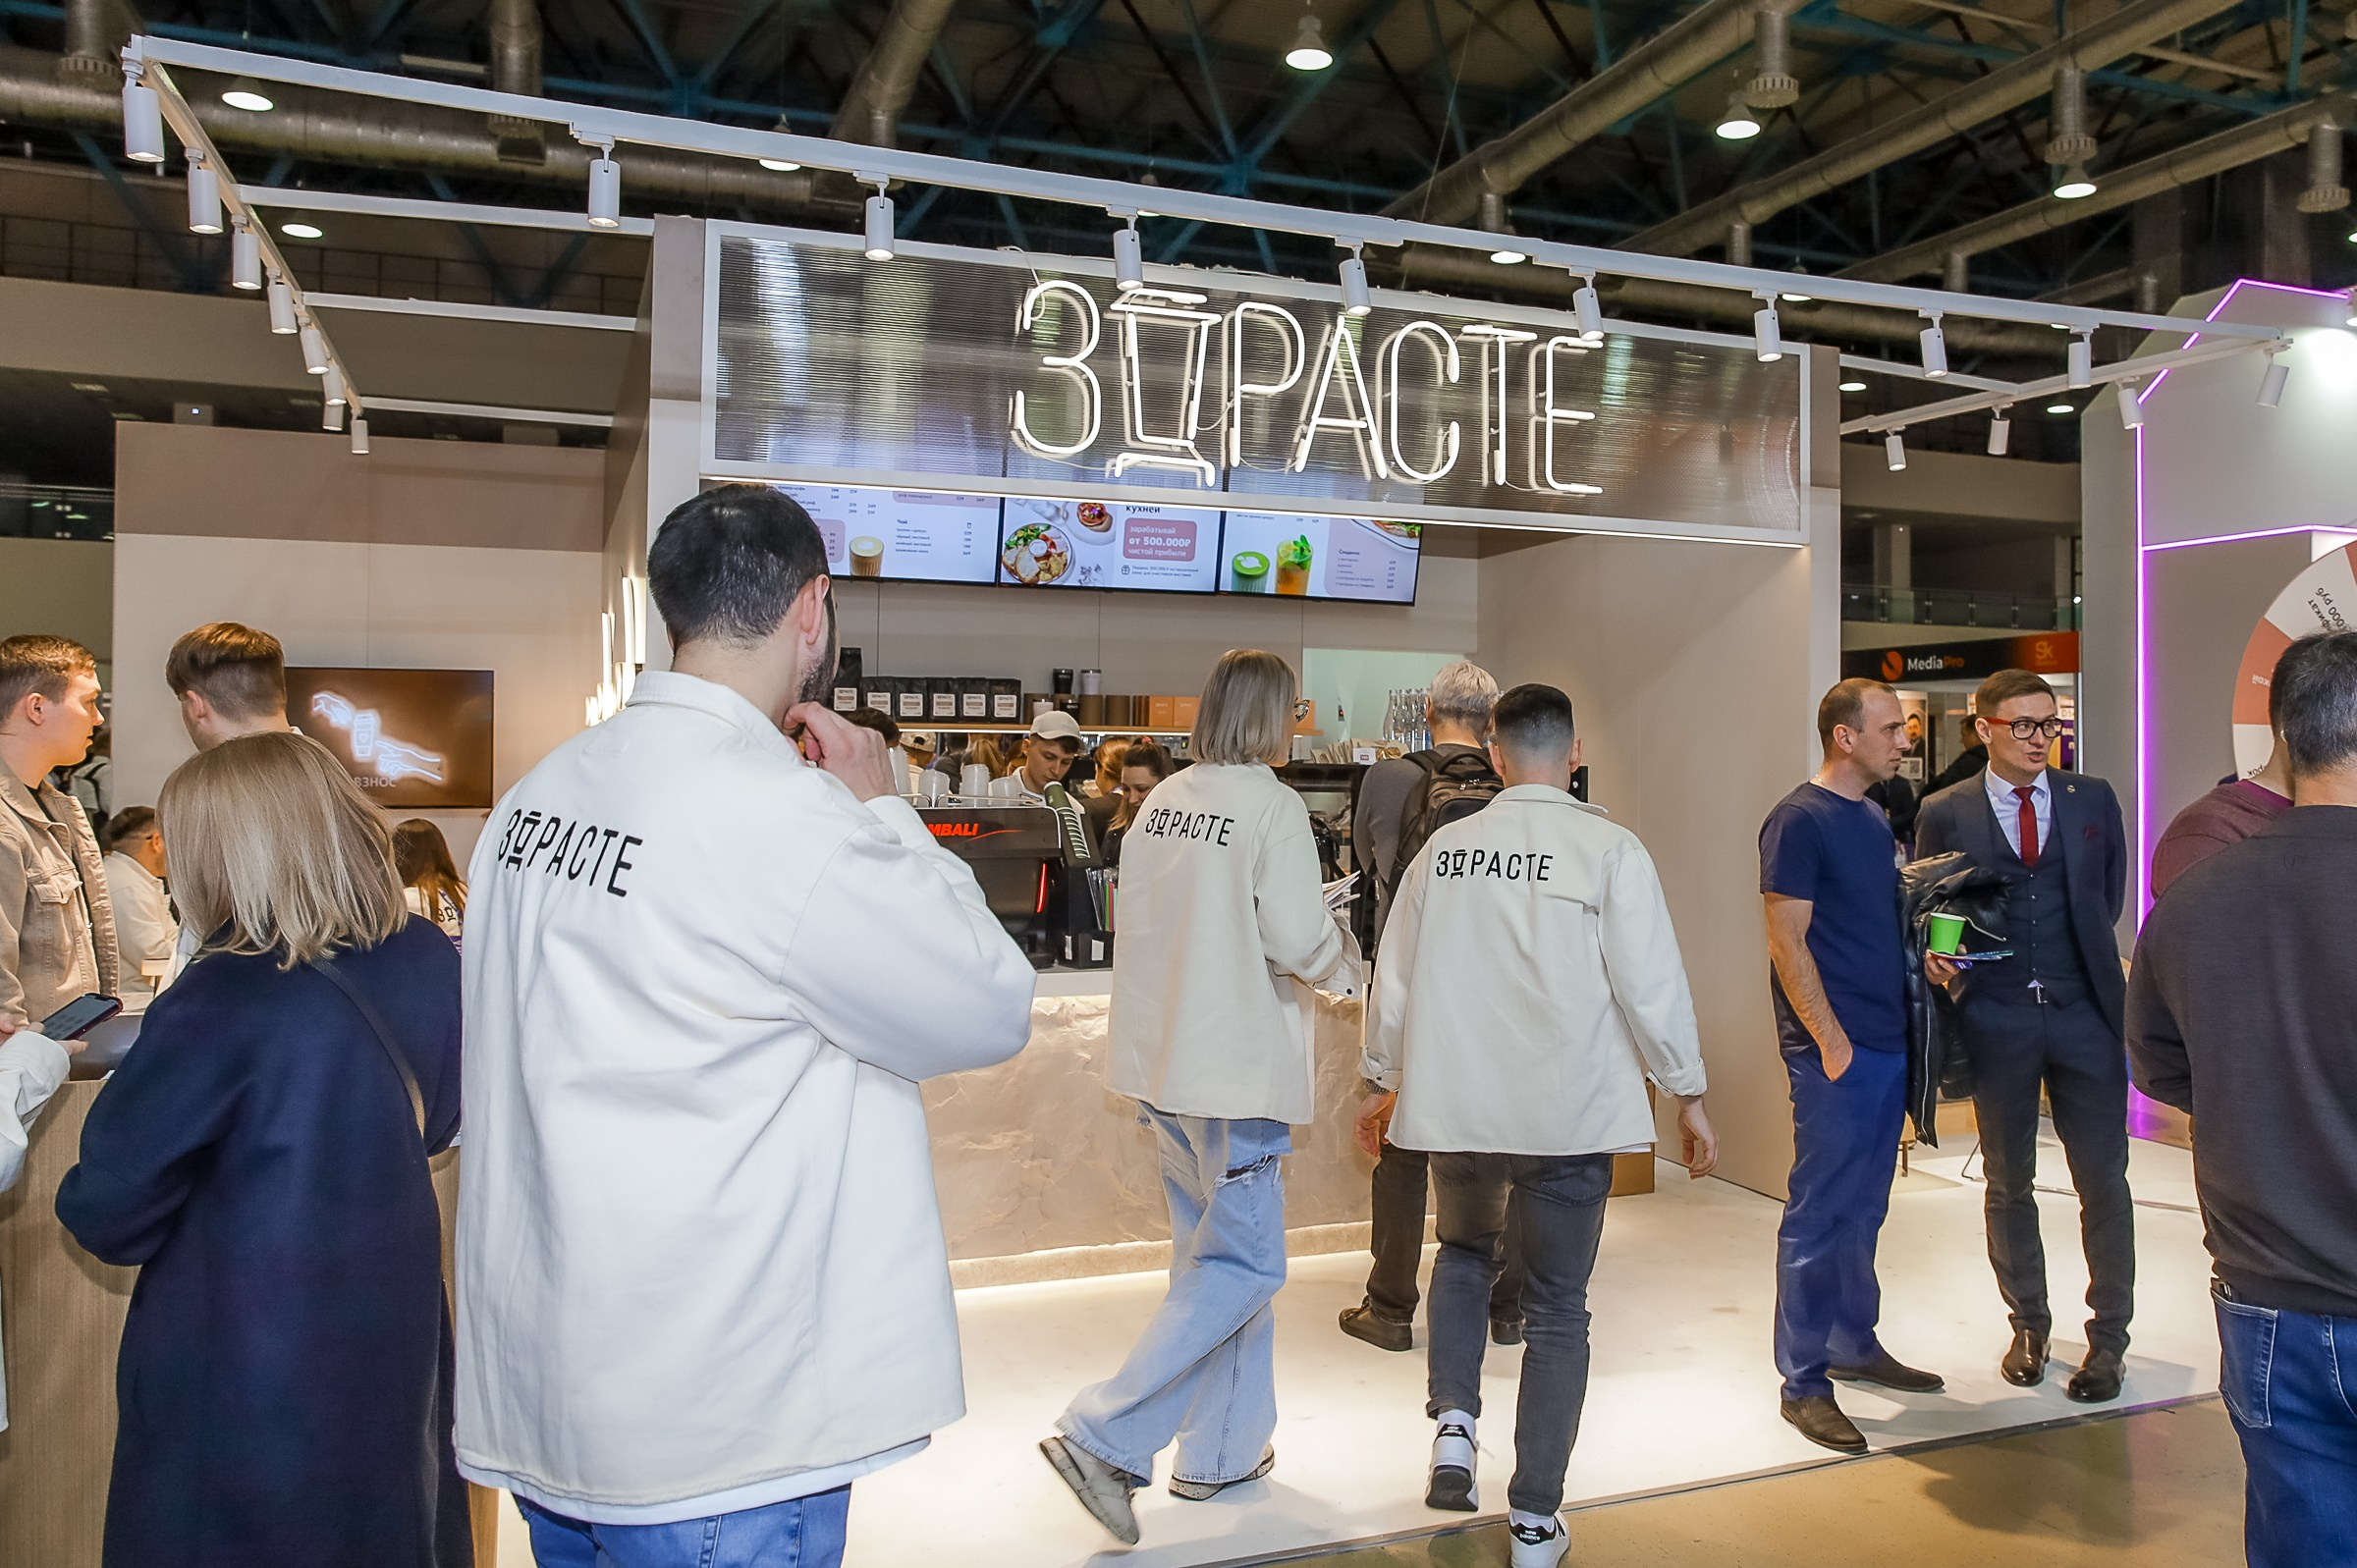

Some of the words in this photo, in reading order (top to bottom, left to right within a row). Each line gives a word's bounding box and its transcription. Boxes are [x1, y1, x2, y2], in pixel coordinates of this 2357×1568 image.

[1014, 279, 1605, 495] ЗДРАСТЕ
[1129, 525, 1177, 535] зарабатывай
[1154, 549, 1187, 558] прибыли
[2315, 587, 2333, 606] руб
[2308, 599, 2332, 631] фикат
[1907, 655, 1965, 672] MediaPro
[926, 823, 979, 837] MBALI
[1144, 807, 1235, 848] ЗДРАСТЕ
[497, 807, 644, 898] ЗДРАСТЕ
[1436, 848, 1554, 883] ЗДРАСТЕ
